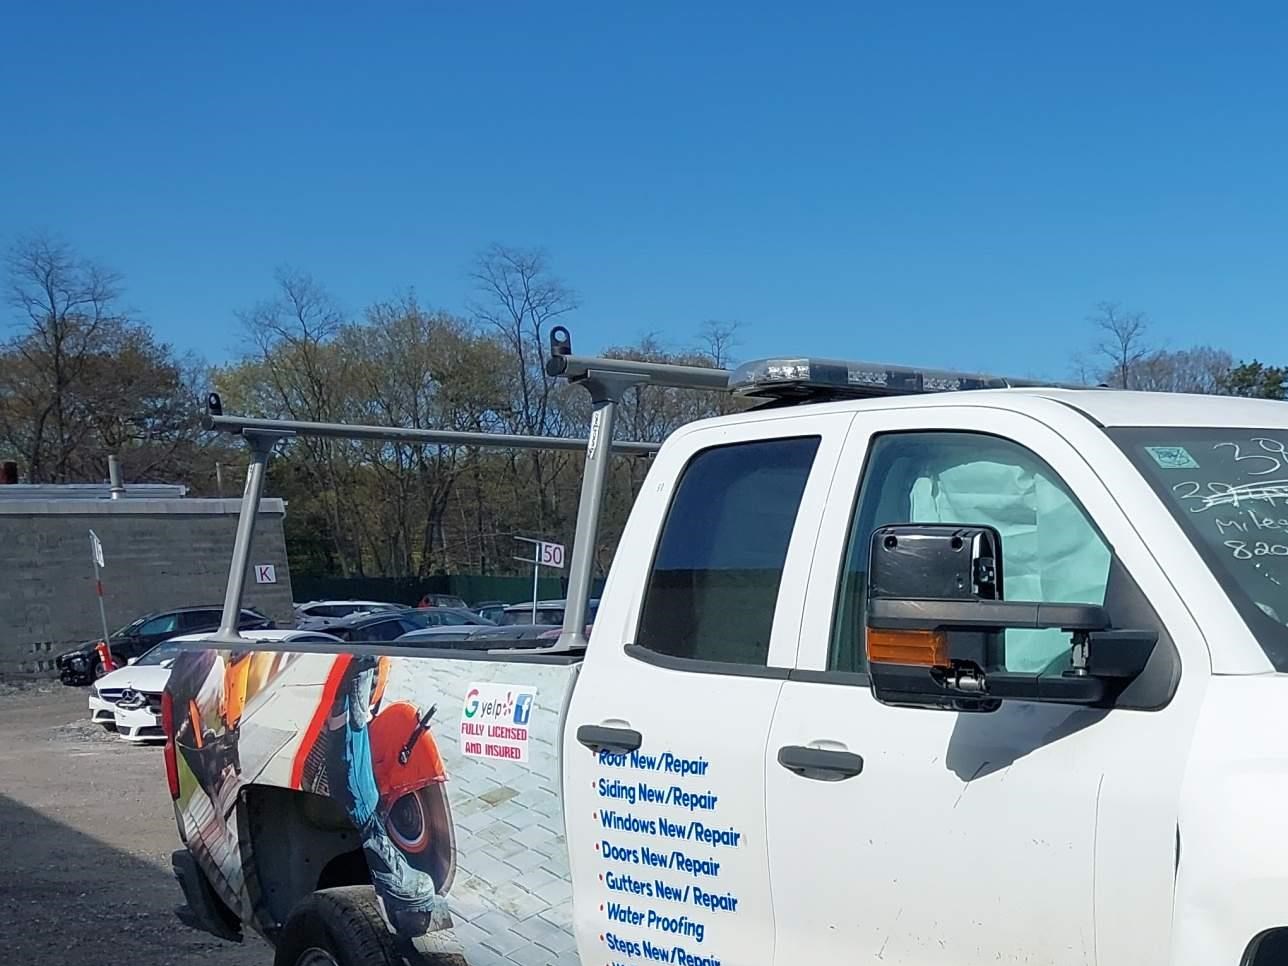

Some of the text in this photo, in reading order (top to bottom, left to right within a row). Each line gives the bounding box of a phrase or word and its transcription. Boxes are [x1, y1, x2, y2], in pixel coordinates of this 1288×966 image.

[543, 544, 562, 565] 50
[259, 566, 271, 581] K
[480, 699, 502, 720] yelp
[461, 722, 527, 741] FULLY LICENSED
[465, 741, 521, 760] AND INSURED
[598, 748, 628, 767] Roof
[598, 777, 636, 805] Siding
[599, 808, 657, 836] Windows
[601, 840, 640, 864] Doors
[605, 871, 652, 897] Gutters
[693, 885, 738, 912] Repair
[607, 901, 705, 942] Water Proofing
[605, 932, 641, 957] Steps
